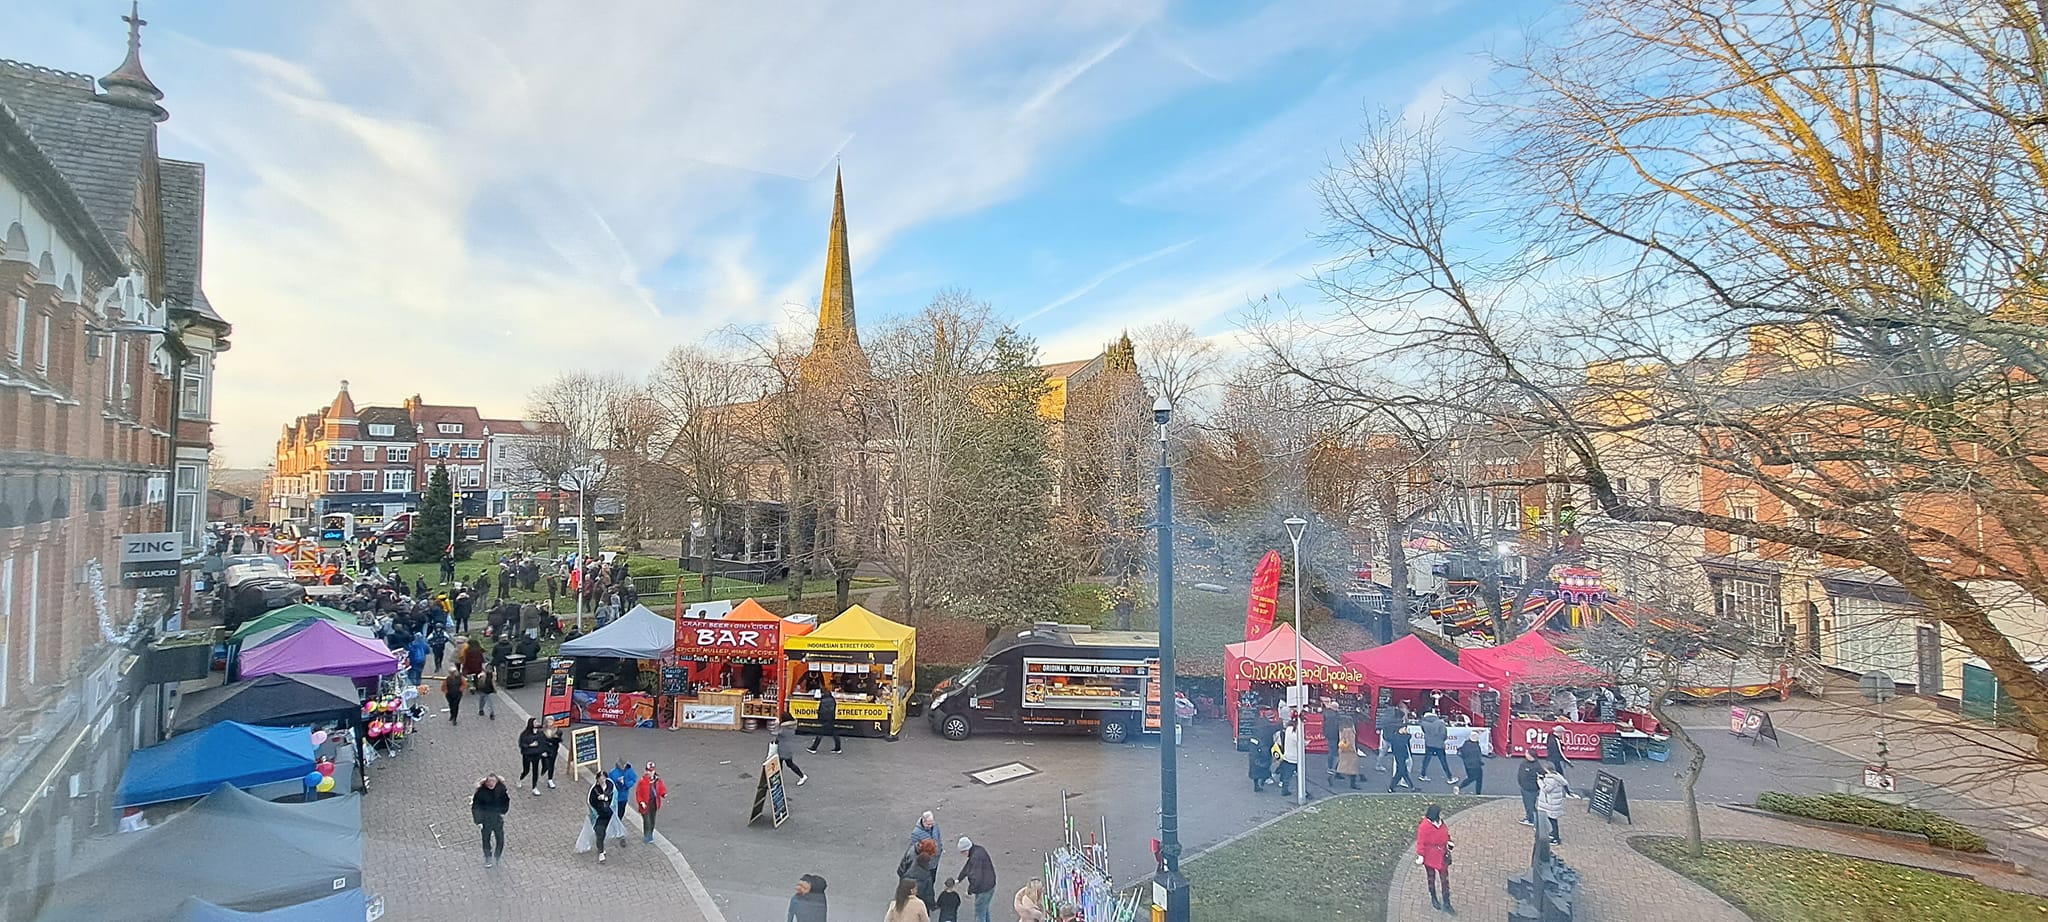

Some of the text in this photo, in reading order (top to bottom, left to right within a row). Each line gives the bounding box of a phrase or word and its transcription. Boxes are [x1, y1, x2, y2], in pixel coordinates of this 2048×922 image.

[128, 541, 174, 553] ZINC
[696, 629, 760, 646] BAR
[1069, 665, 1092, 673] PUNJABI
[1093, 666, 1121, 674] FLAVOURS
[1319, 665, 1363, 683] Chocolate
